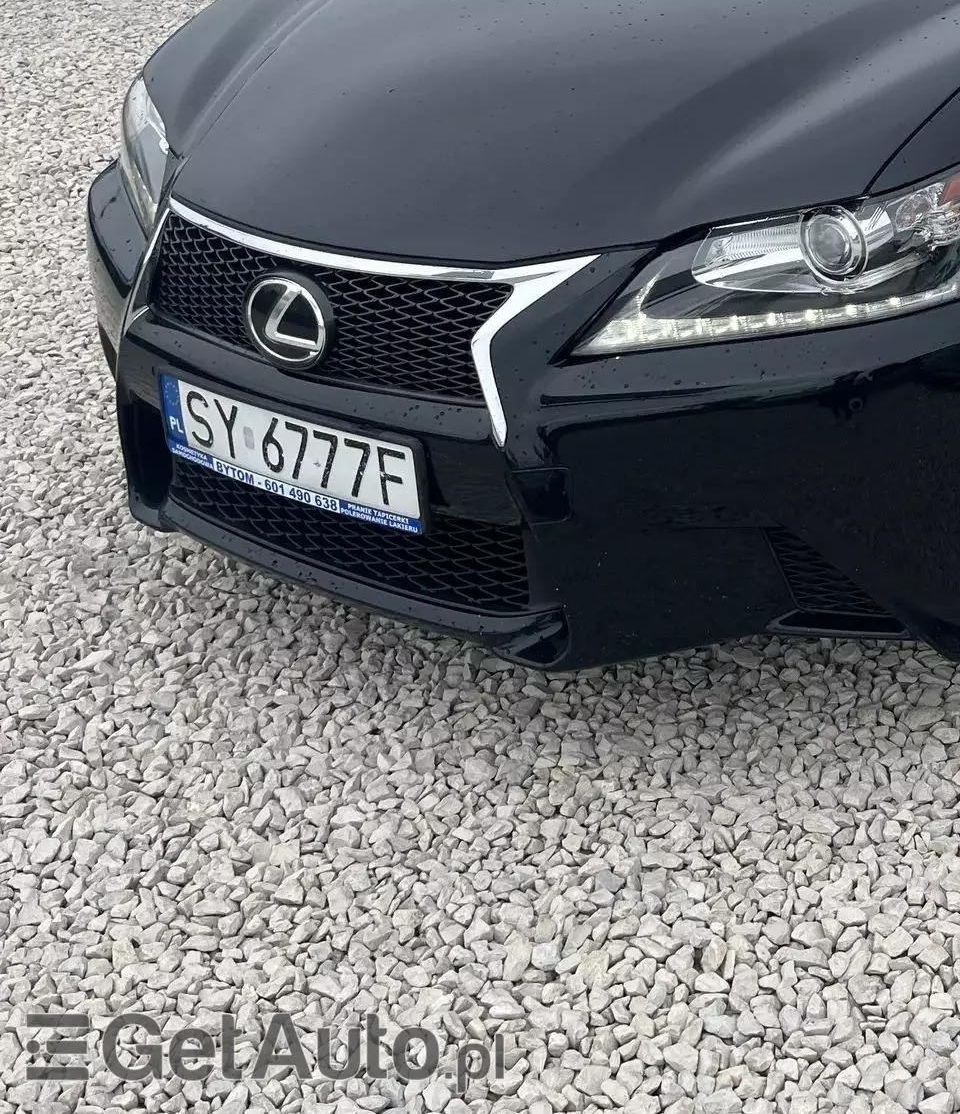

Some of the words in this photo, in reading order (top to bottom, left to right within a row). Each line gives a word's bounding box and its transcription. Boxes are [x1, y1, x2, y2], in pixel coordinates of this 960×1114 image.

[170, 416, 184, 433] PL
[186, 390, 238, 459] SY
[262, 417, 405, 505] 6777F
[216, 461, 254, 485] BYTOM
[264, 479, 285, 495] 601
[289, 489, 311, 503] 490
[315, 496, 337, 511] 638
[340, 507, 388, 525] POLEROWANIE
[389, 520, 417, 534] LAKIERU
